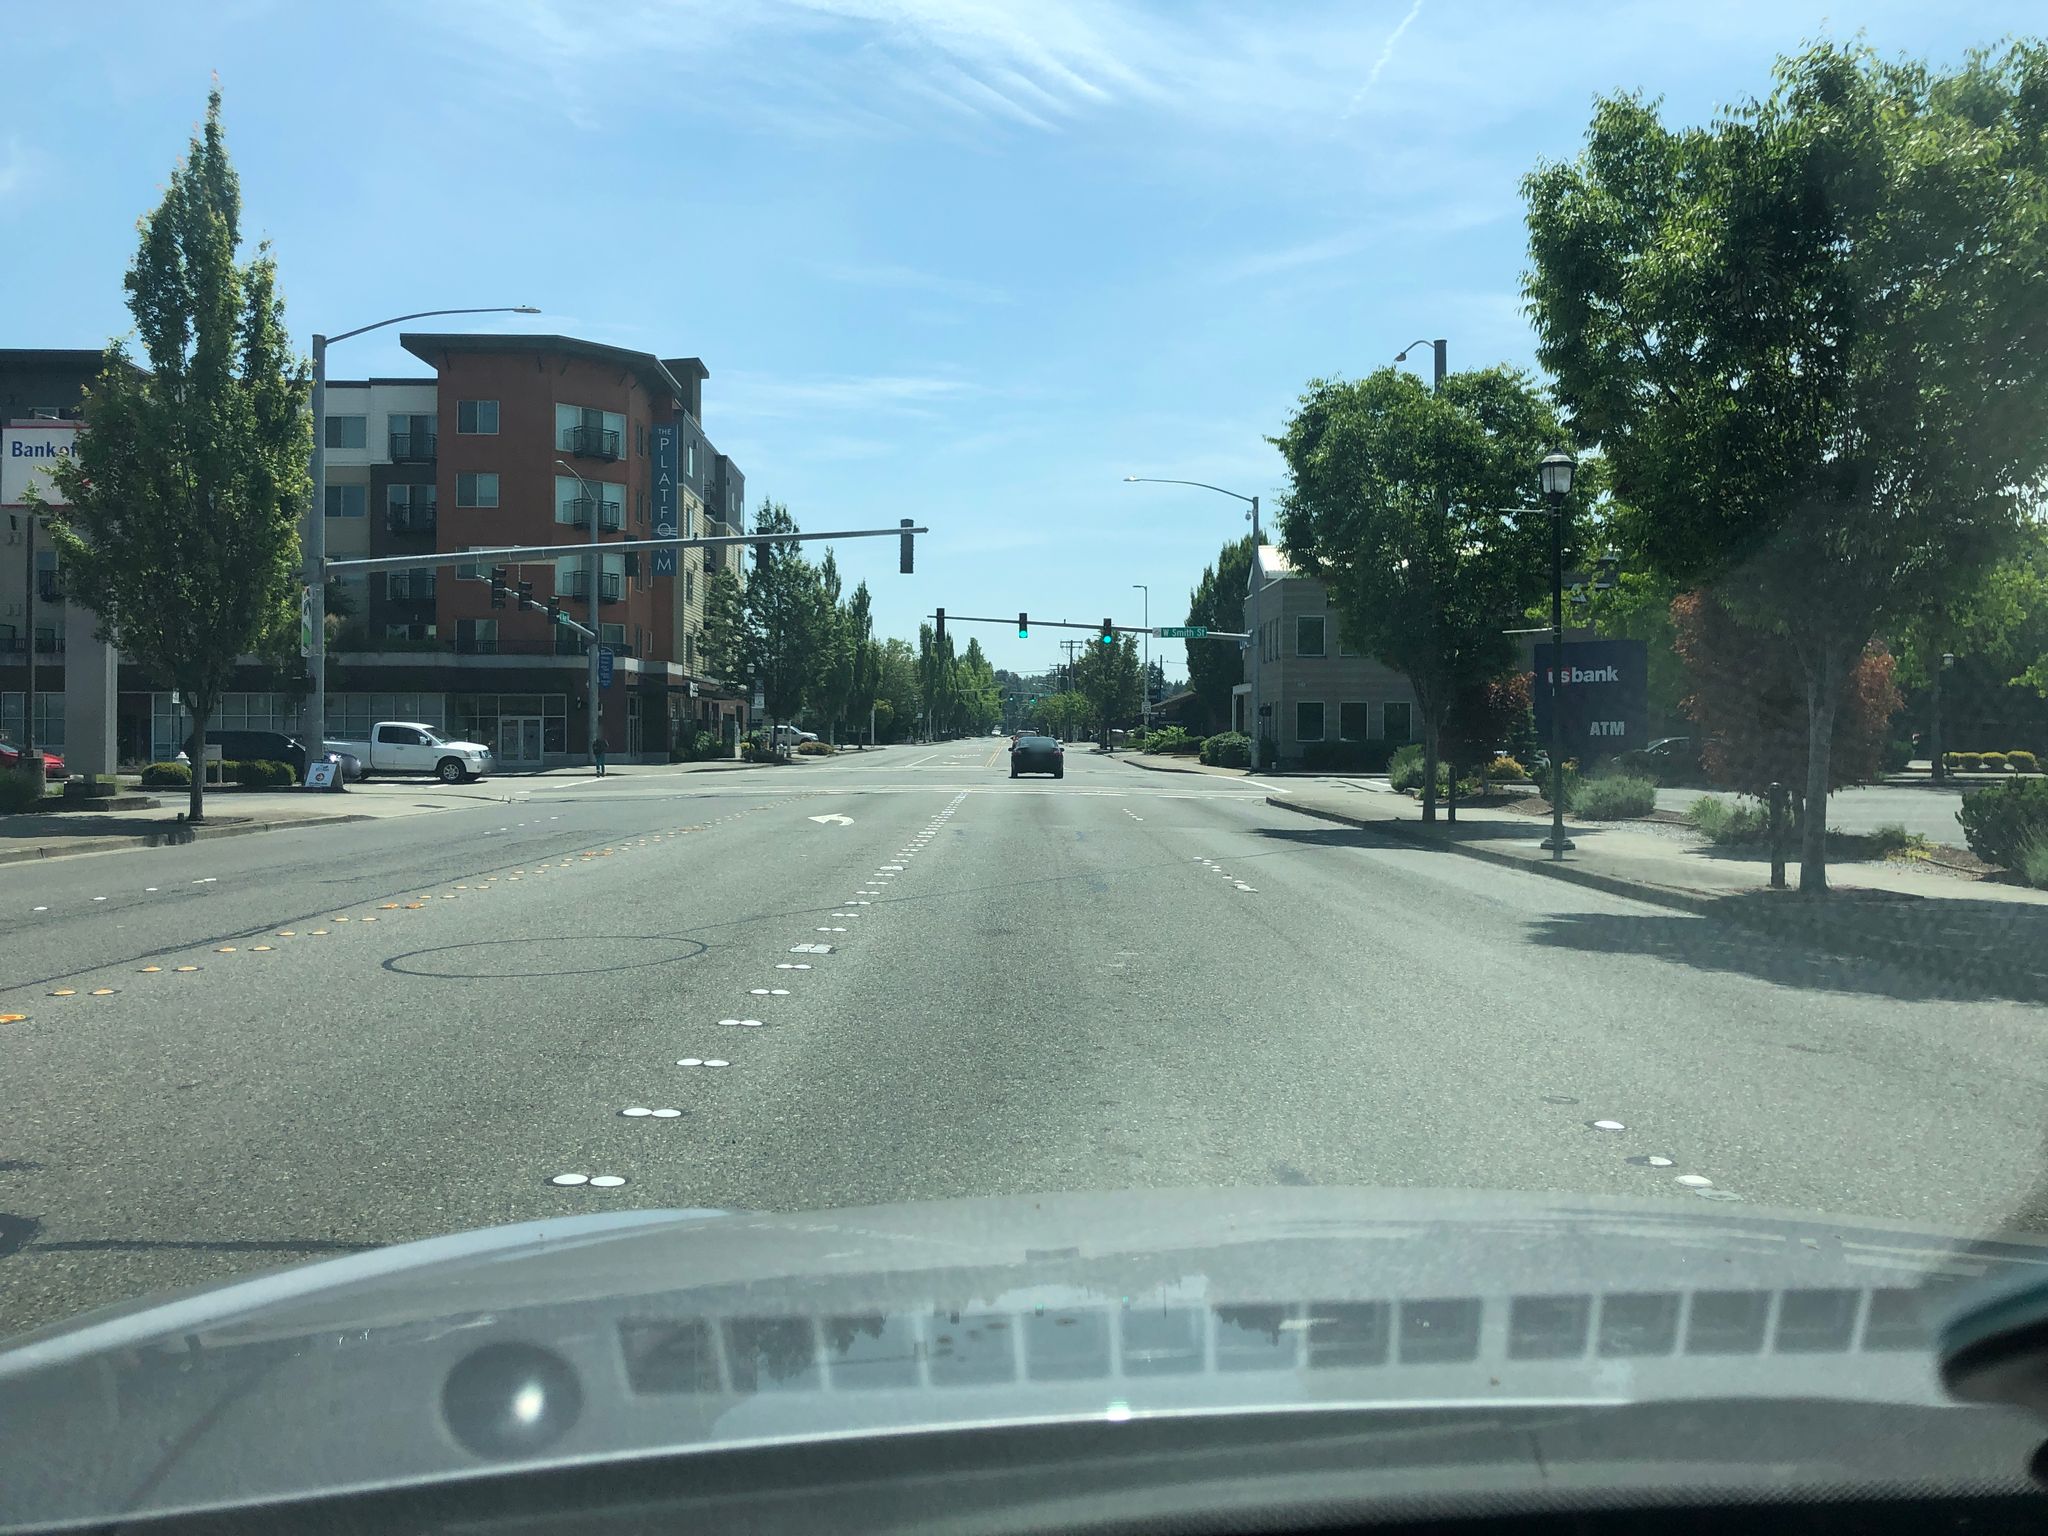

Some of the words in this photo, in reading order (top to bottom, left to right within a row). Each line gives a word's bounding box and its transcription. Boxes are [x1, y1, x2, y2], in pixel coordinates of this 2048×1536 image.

[658, 428, 672, 436] THE
[12, 441, 56, 458] Bank
[60, 441, 78, 458] of
[1162, 629, 1169, 637] W
[1171, 628, 1195, 638] Smith
[1196, 628, 1205, 637] St
[1589, 721, 1625, 736] ATM
